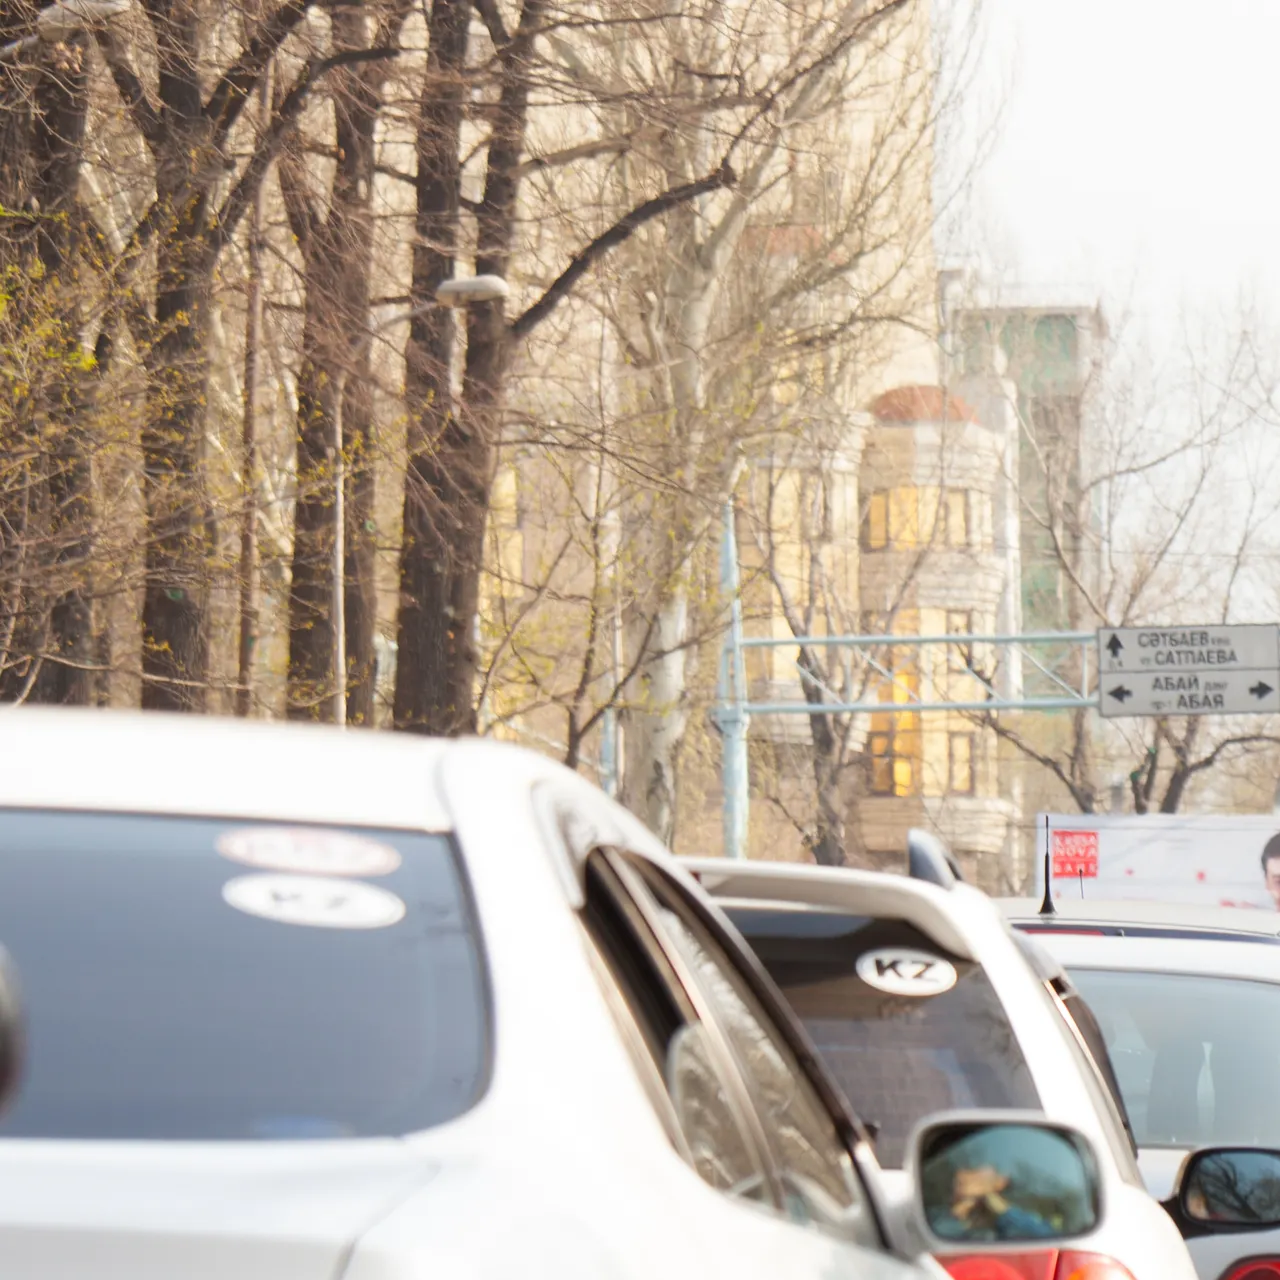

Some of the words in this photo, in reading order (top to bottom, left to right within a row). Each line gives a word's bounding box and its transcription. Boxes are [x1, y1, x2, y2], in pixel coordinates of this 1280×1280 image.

[1137, 631, 1209, 648] СӘТБАЕВ
[1154, 649, 1238, 666] САТПАЕВА
[1152, 674, 1199, 692] АБАЙ
[1176, 694, 1225, 710] АБАЯ
[873, 957, 940, 983] KZ
